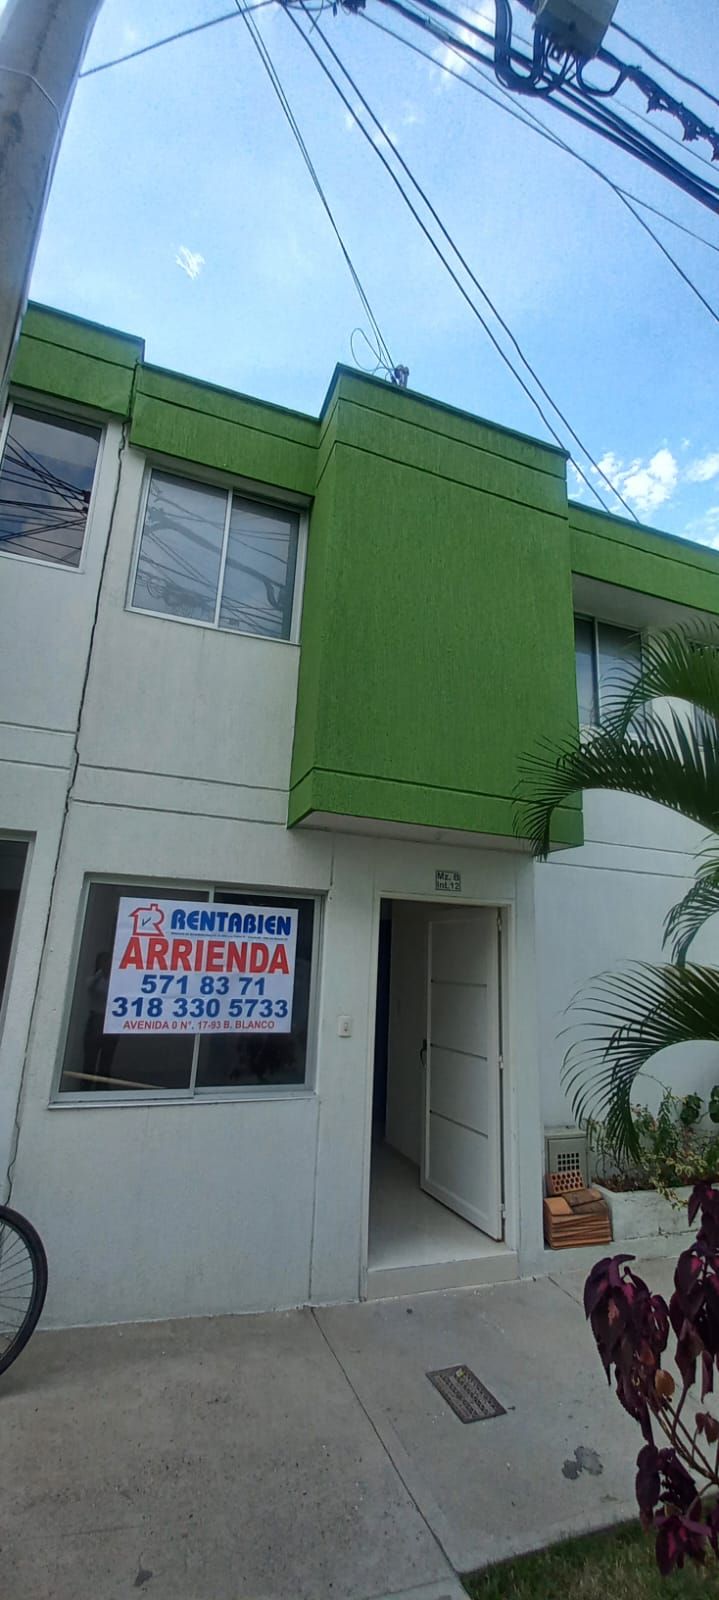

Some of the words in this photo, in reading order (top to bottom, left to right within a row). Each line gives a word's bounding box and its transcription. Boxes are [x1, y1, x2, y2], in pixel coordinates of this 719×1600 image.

[170, 909, 291, 936] RENTABIEN
[119, 937, 290, 975] ARRIENDA
[141, 975, 188, 995] 571
[200, 976, 230, 996] 83
[239, 977, 265, 996] 71
[112, 996, 163, 1018] 318
[173, 998, 220, 1018] 330
[228, 999, 288, 1018] 5733
[123, 1020, 169, 1030] AVENIDA
[198, 1020, 221, 1030] 17-93
[223, 1020, 233, 1030] B.
[235, 1020, 275, 1030] BLANCO
